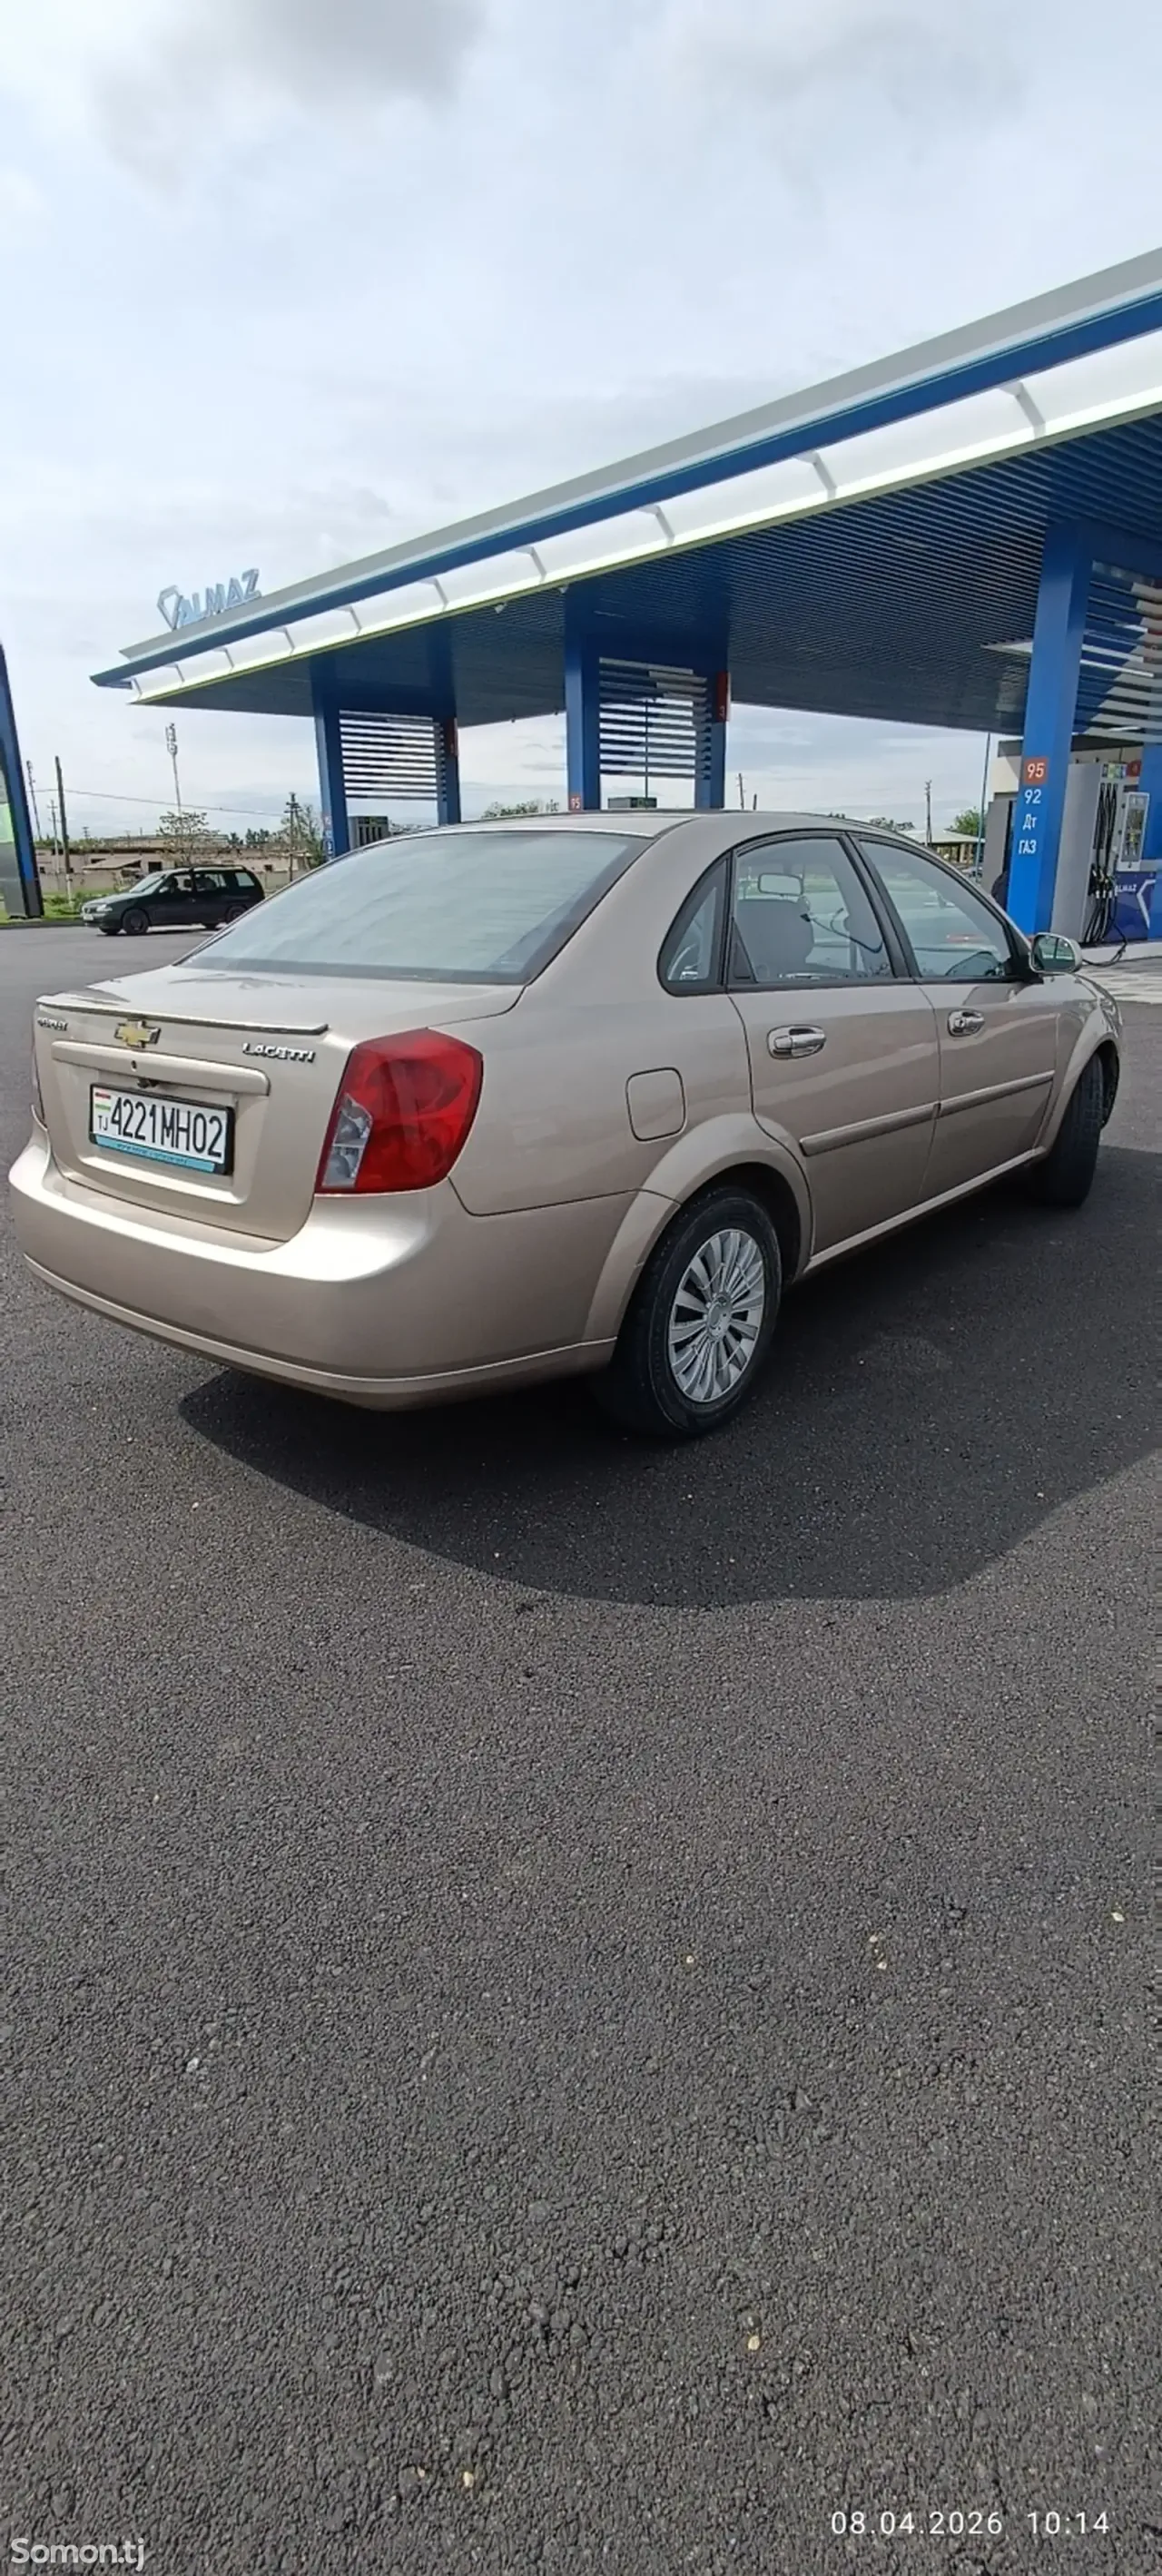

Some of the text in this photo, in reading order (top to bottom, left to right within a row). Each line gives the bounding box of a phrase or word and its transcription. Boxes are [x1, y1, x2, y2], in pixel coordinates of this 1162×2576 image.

[176, 568, 262, 628] ALMAZ
[1027, 762, 1045, 779] 95
[1024, 789, 1042, 804] 92
[1022, 813, 1038, 831] Дт
[1019, 840, 1038, 854] ГАЗ
[98, 1116, 109, 1131] TJ
[111, 1096, 223, 1157] 4221MH02
